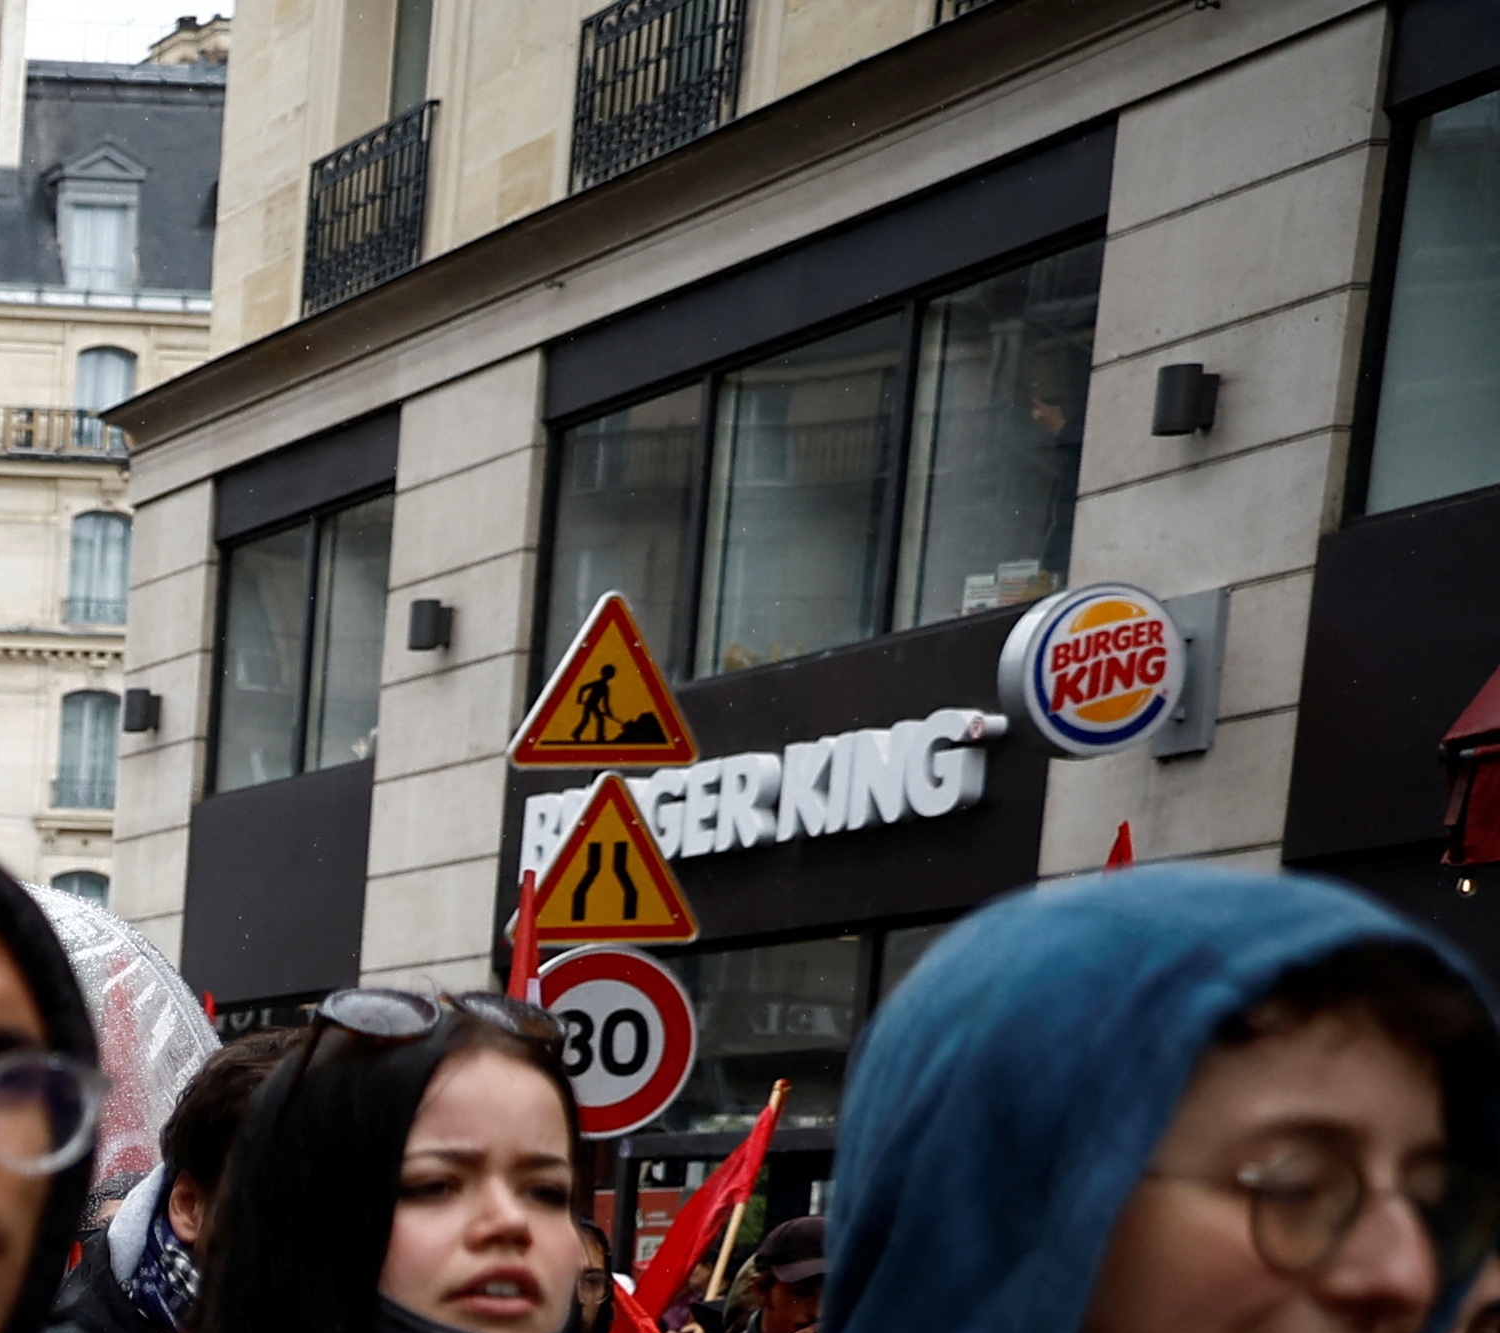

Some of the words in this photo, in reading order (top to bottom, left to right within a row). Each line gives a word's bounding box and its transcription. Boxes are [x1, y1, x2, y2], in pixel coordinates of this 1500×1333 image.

[1051, 619, 1165, 674] BURGER
[1051, 647, 1168, 714] KING
[777, 707, 986, 843] KING
[560, 1008, 649, 1078] 30
